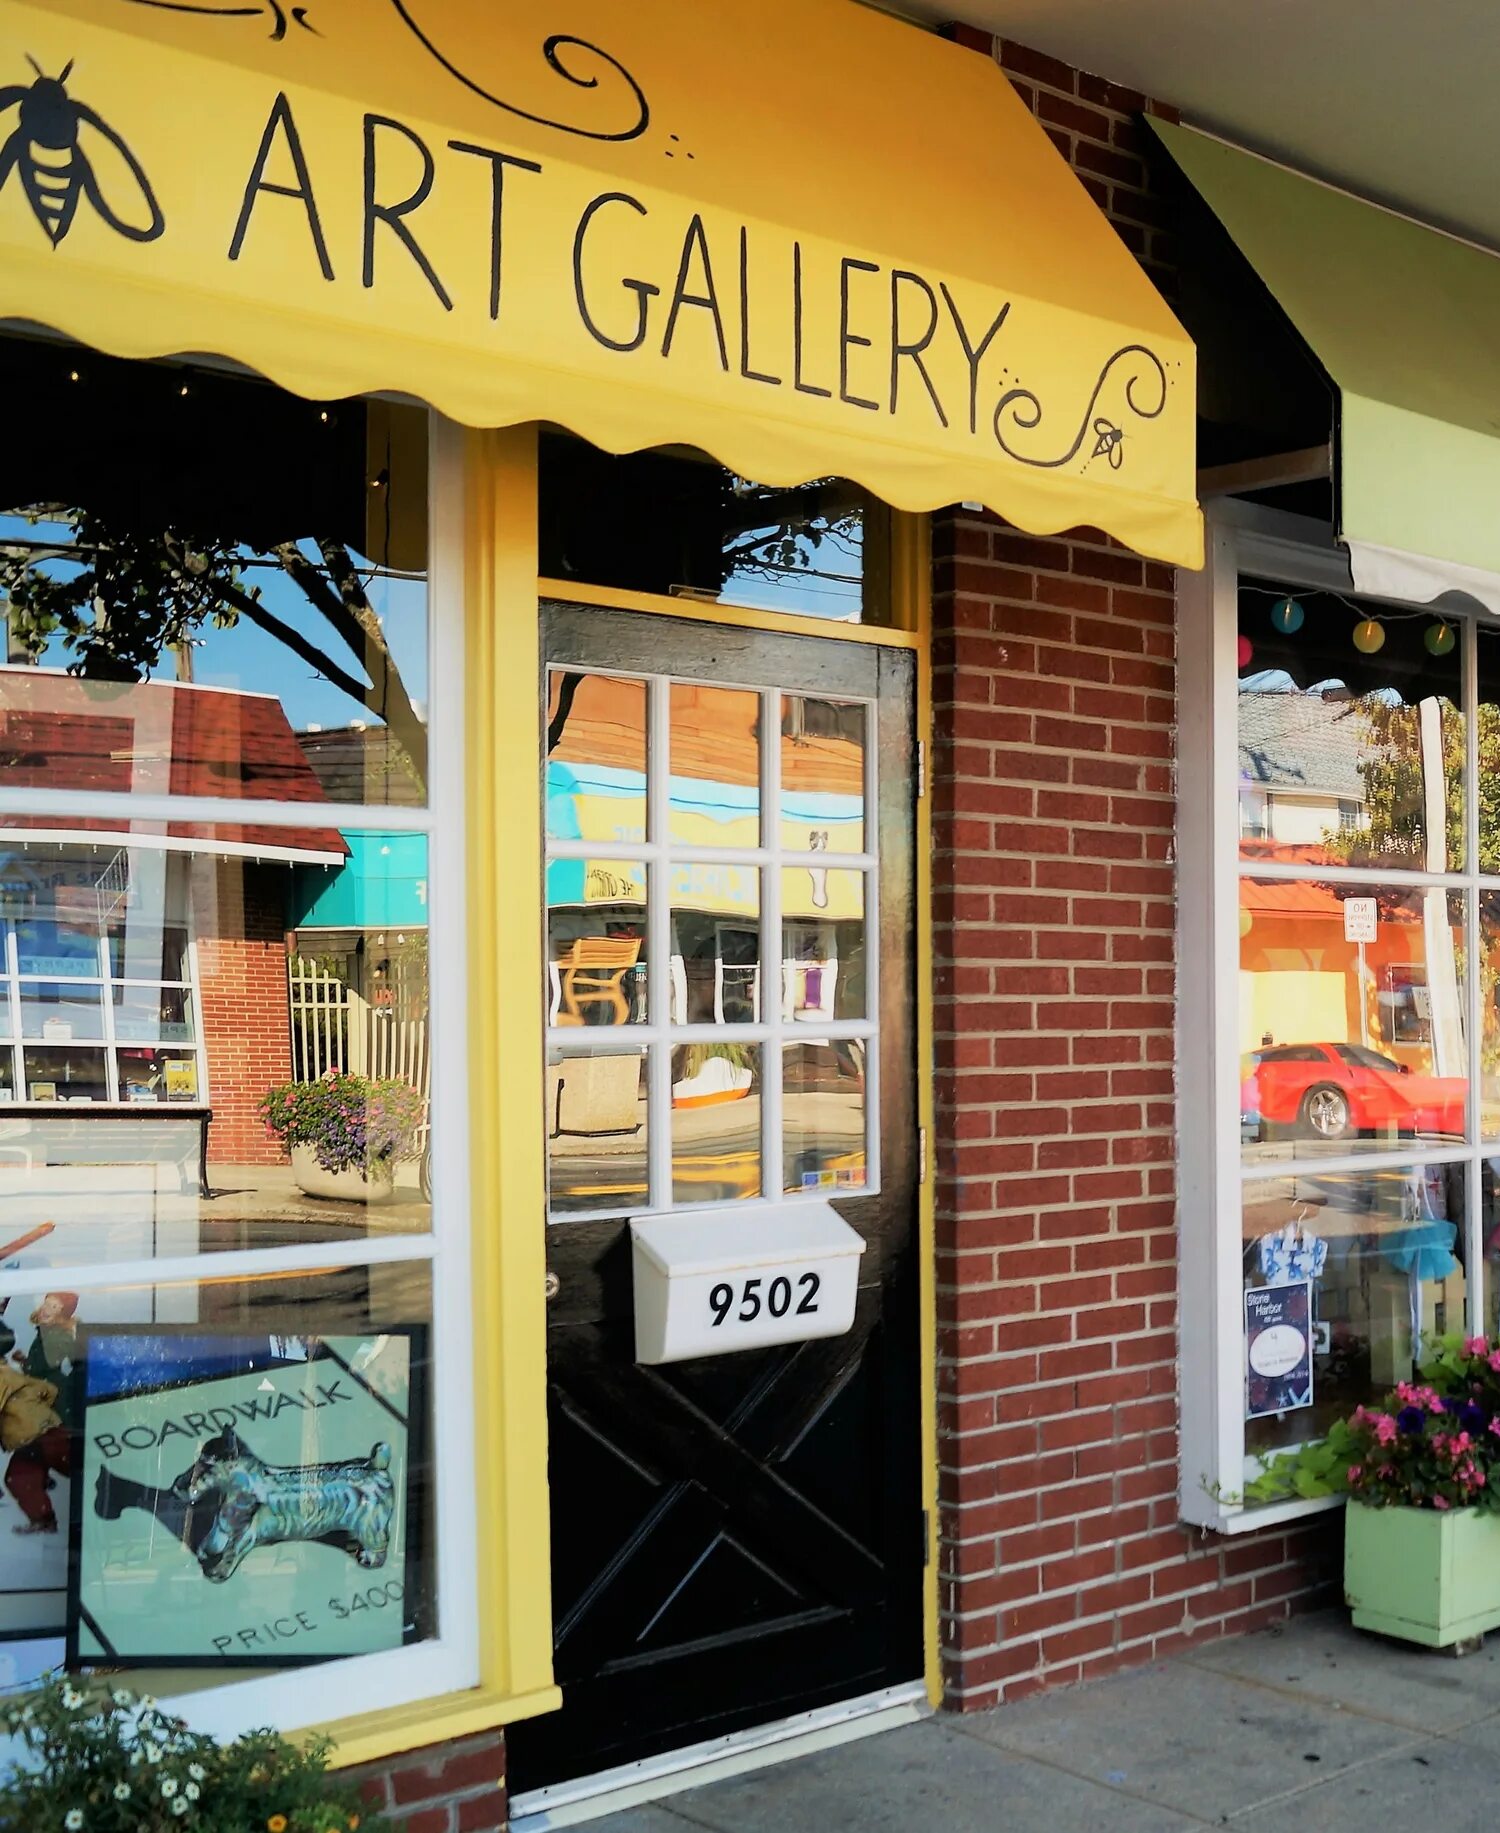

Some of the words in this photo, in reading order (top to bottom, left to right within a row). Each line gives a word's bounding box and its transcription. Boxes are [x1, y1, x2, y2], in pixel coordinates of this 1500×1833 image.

[229, 92, 541, 319] ART
[573, 192, 1011, 434] GALLERY
[708, 1272, 821, 1327] 9502
[1256, 1303, 1282, 1317] Harbor
[94, 1380, 353, 1459] BOARDWALK
[211, 1611, 319, 1656] PRICE
[328, 1581, 405, 1621] $400
